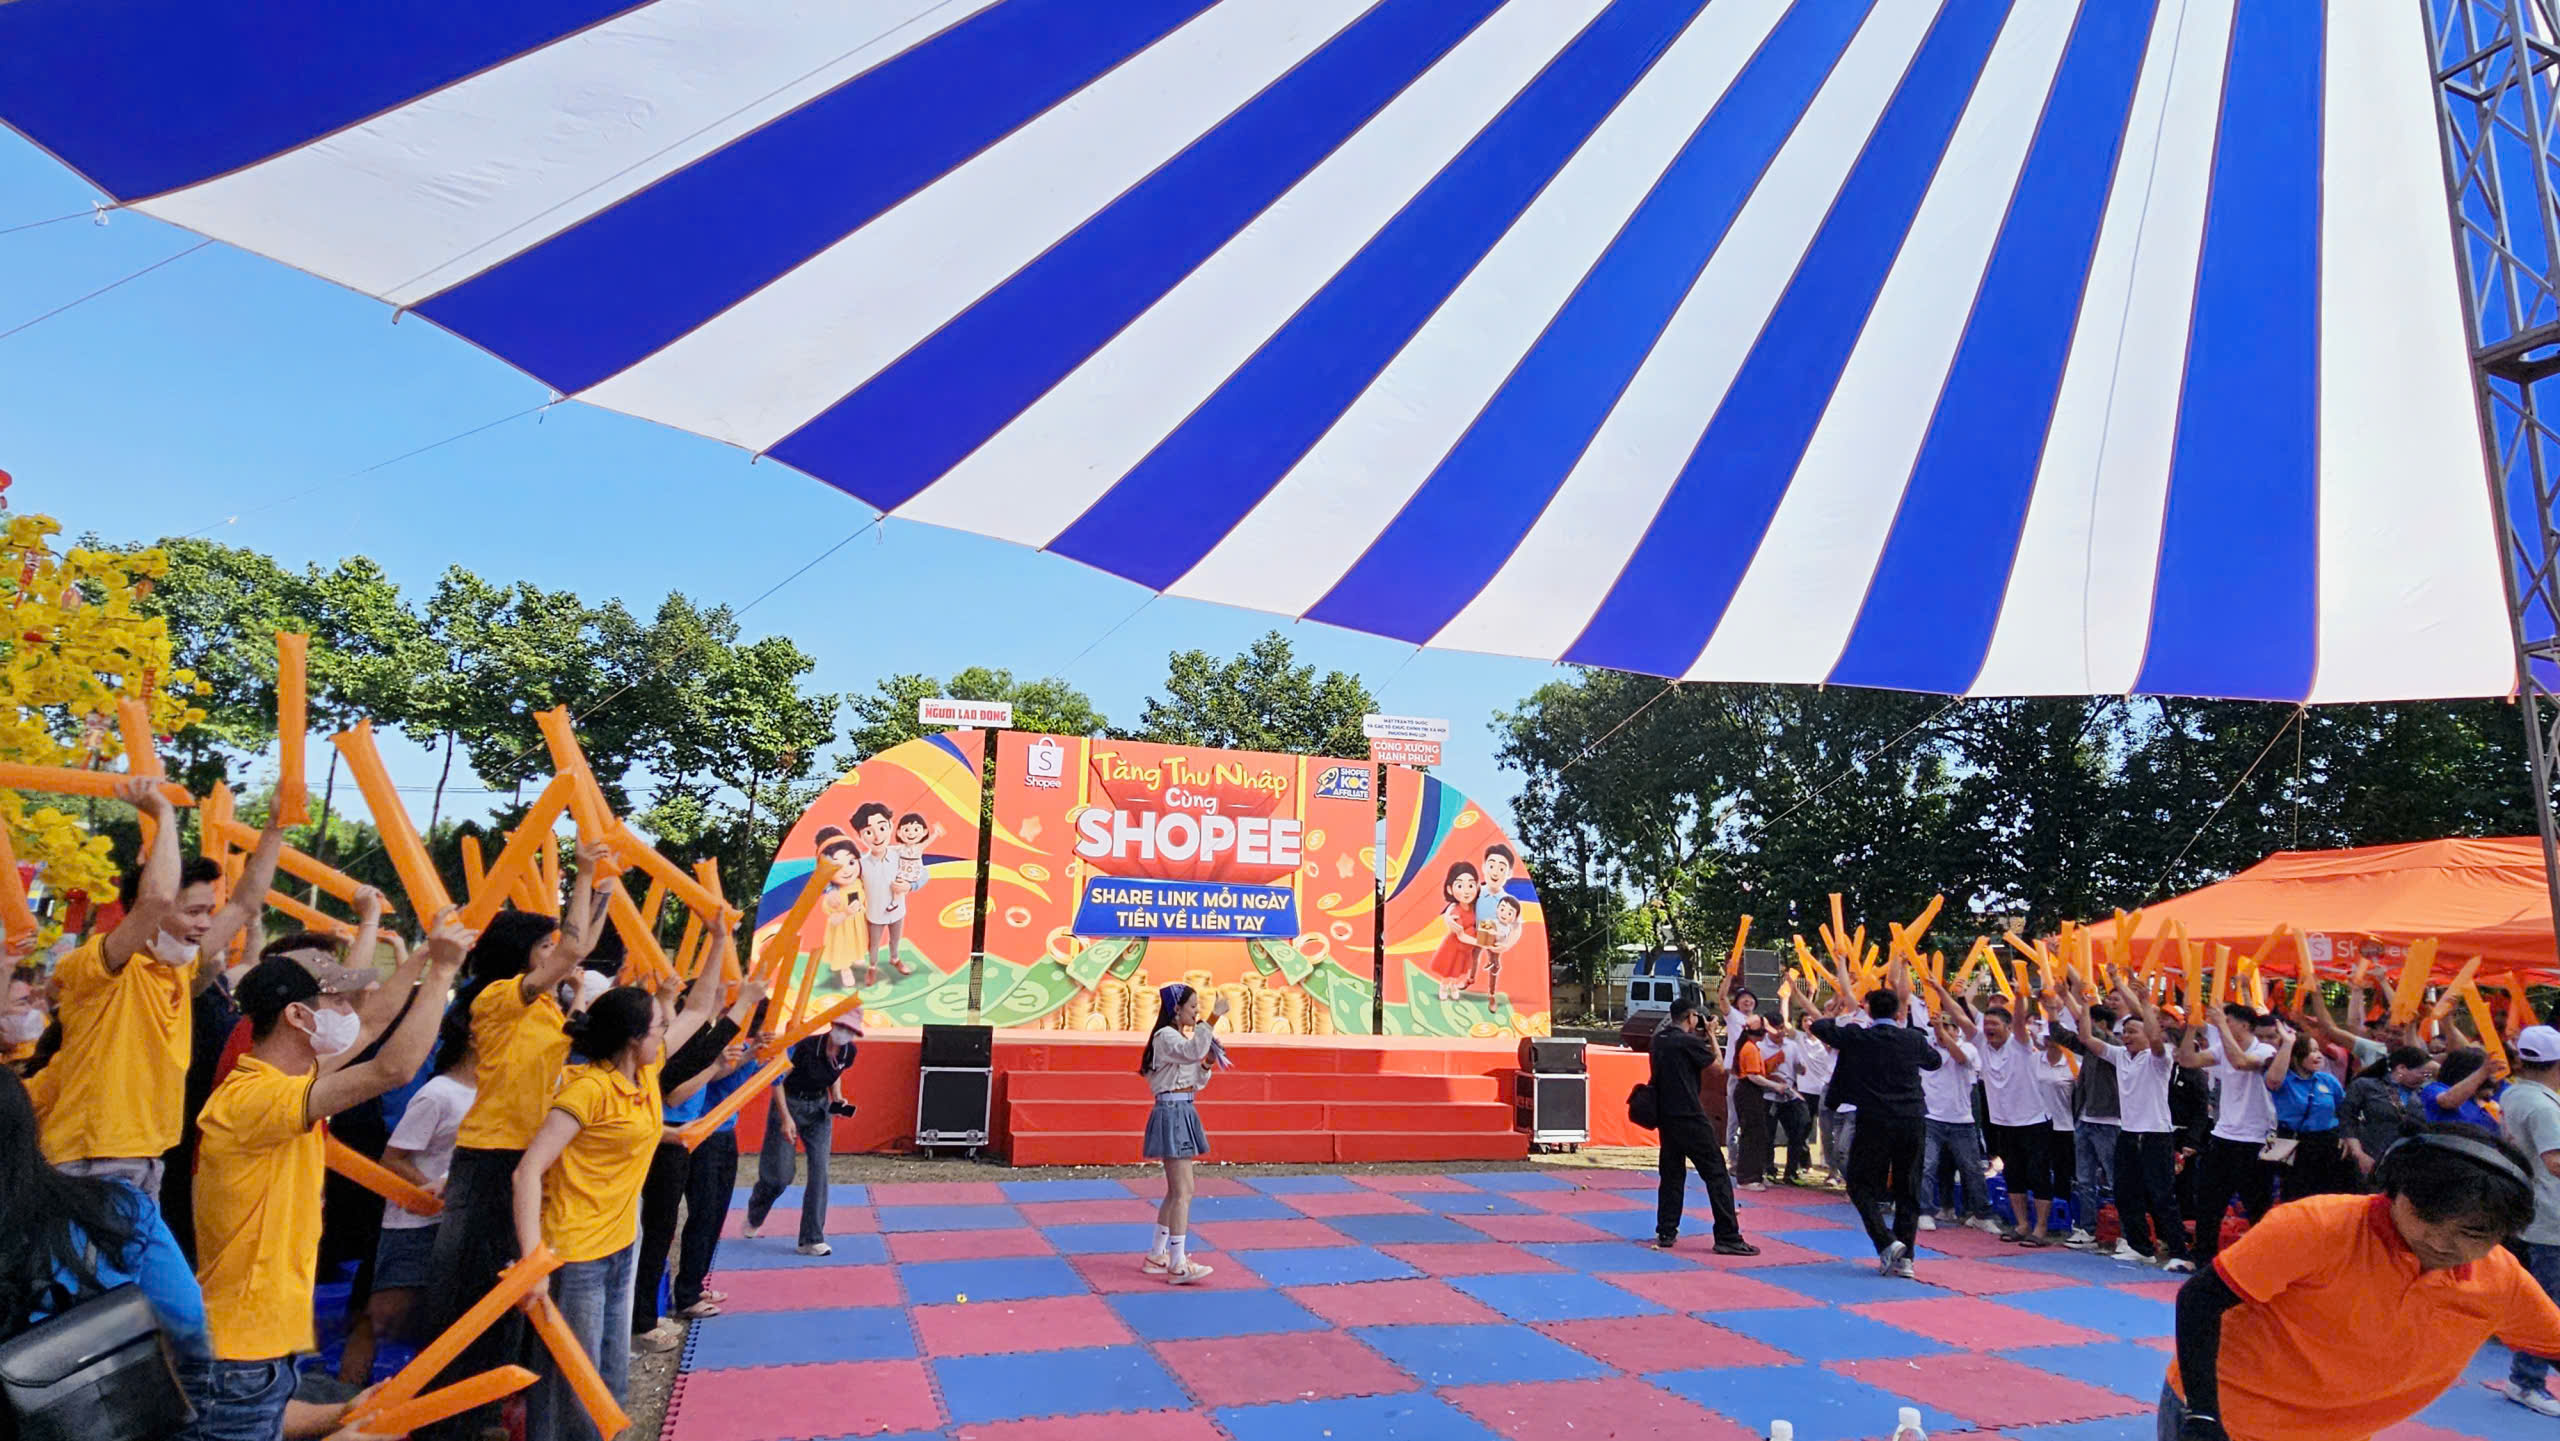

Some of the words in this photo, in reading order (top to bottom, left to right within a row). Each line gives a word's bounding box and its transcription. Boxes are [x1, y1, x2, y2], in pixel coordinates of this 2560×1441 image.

[1025, 775, 1062, 790] Shopee
[1094, 752, 1161, 790] Tăng
[1163, 756, 1210, 786] Thu
[1215, 762, 1288, 799] Nhập
[1340, 768, 1369, 777] SHOPEE
[1165, 787, 1218, 814] Cùng
[1333, 788, 1369, 799] AFFILIATE
[1076, 808, 1302, 866] SHOPEE
[1091, 888, 1153, 905] SHARE
[1157, 891, 1199, 907] LINK
[1203, 887, 1237, 908] MỖI
[1242, 892, 1290, 910] NGÀY
[1116, 907, 1158, 928] TIỀN
[1163, 908, 1187, 929] VỀ
[1191, 910, 1230, 930] LIỀN
[1234, 915, 1266, 931] TAY
